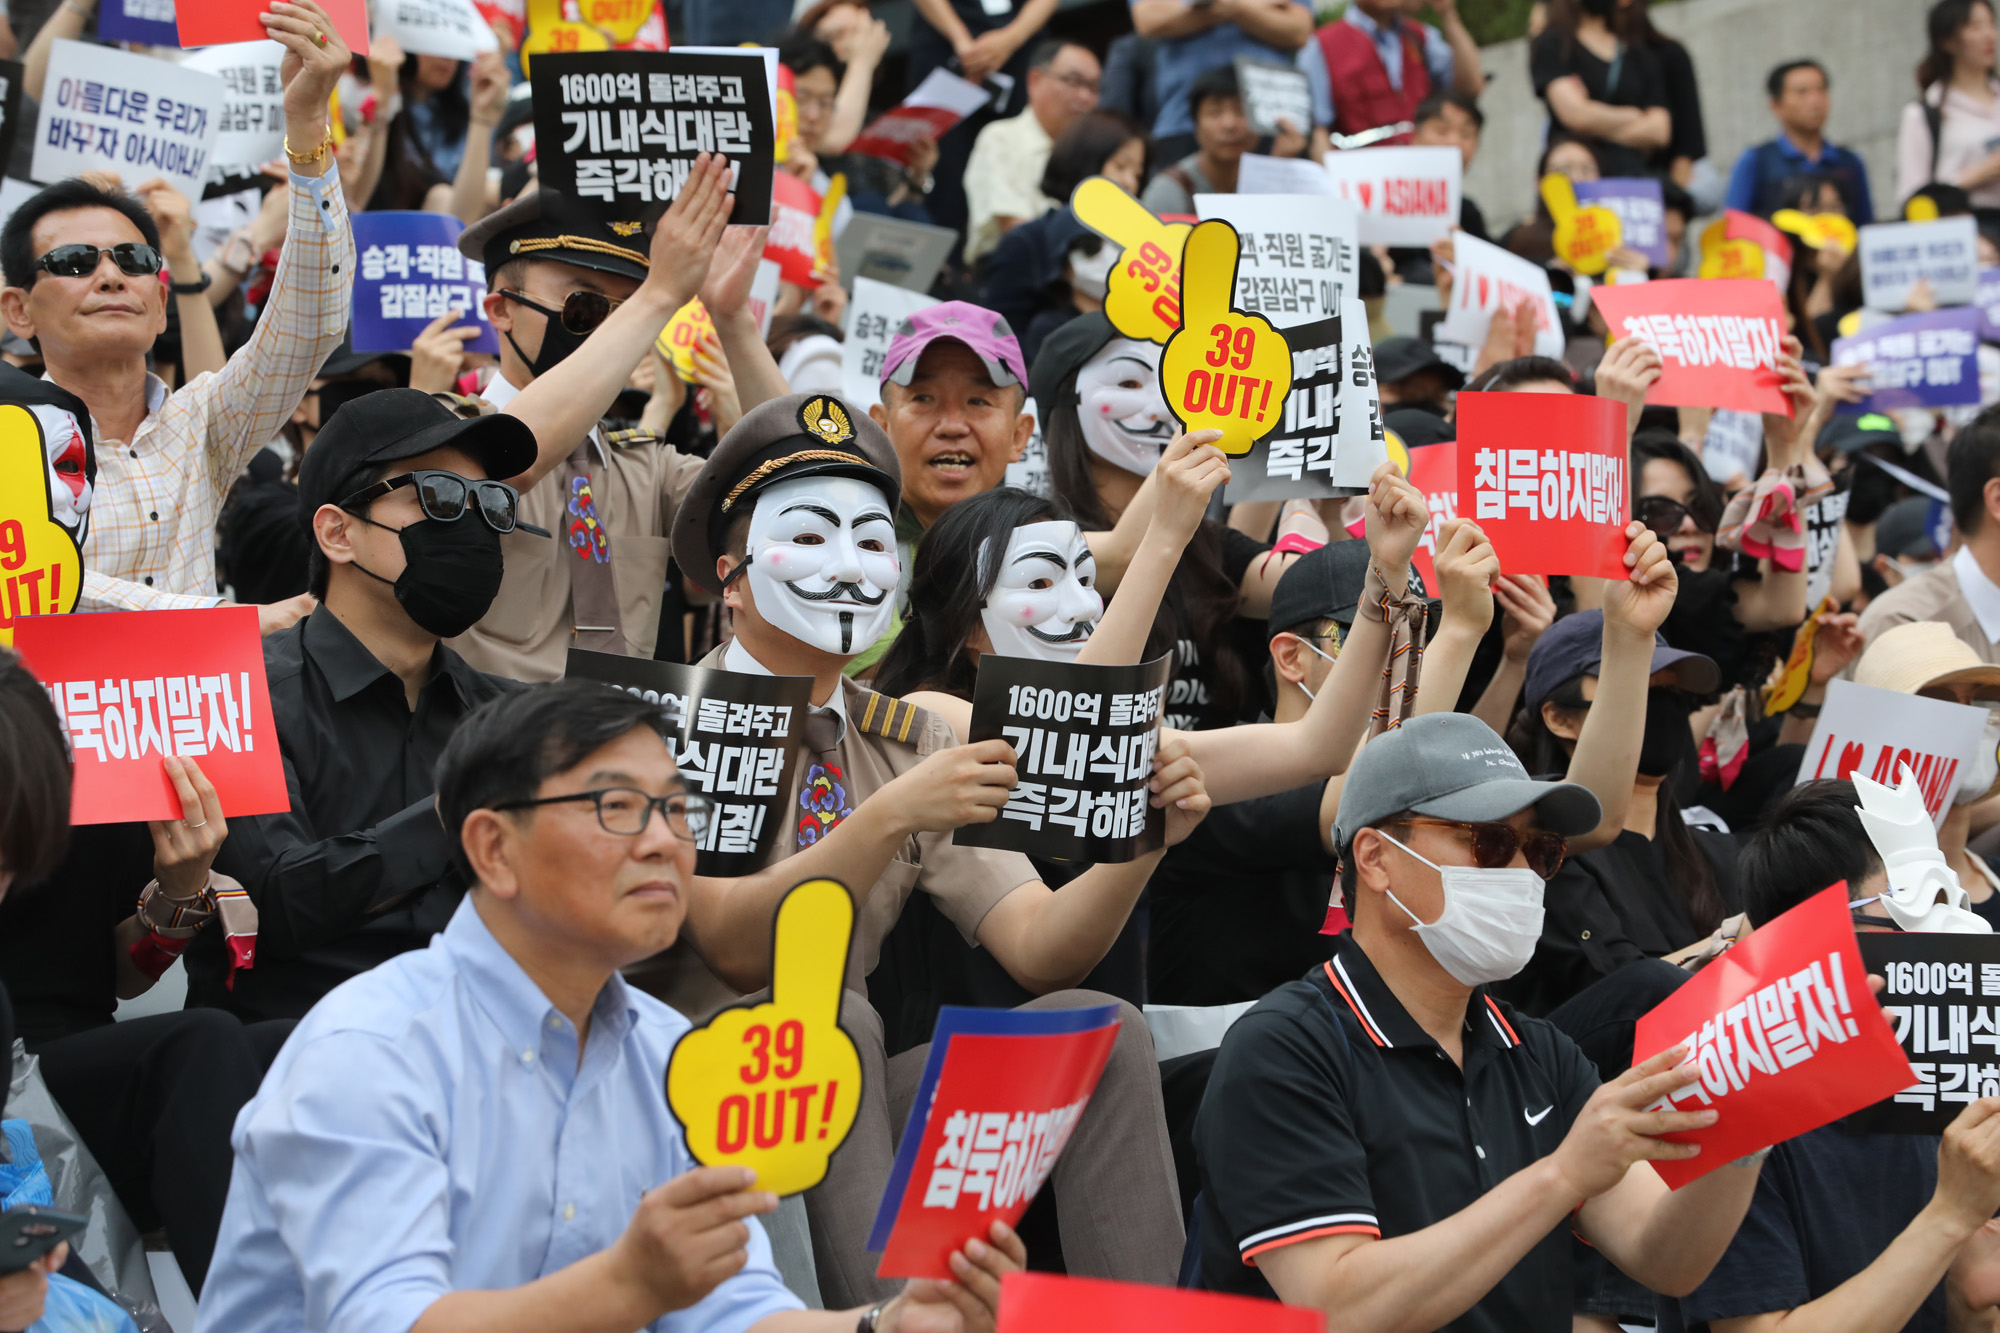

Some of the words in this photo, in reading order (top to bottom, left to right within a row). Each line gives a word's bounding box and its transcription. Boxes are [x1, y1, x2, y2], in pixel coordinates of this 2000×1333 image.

[57, 77, 149, 124] 아름다운
[155, 98, 207, 139] 우리가
[560, 72, 641, 105] 1600억
[648, 73, 746, 104] 돌려주고
[48, 117, 119, 159] 바꾸자
[561, 109, 752, 154] 기내식대란
[1127, 241, 1173, 293] 39
[1308, 233, 1353, 274] 굶기는
[1239, 276, 1316, 314] 갑질삼구
[1205, 323, 1257, 371] 39
[1183, 369, 1274, 423] OUT!
[1474, 447, 1623, 527] 침묵하지말자!
[697, 697, 792, 738] 돌려주고
[1008, 685, 1102, 726] 1600억
[1884, 962, 1973, 996] 1600억
[740, 1018, 804, 1085] 39
[1642, 951, 1861, 1112] 묵하지말자!
[716, 1079, 838, 1154] OUT!
